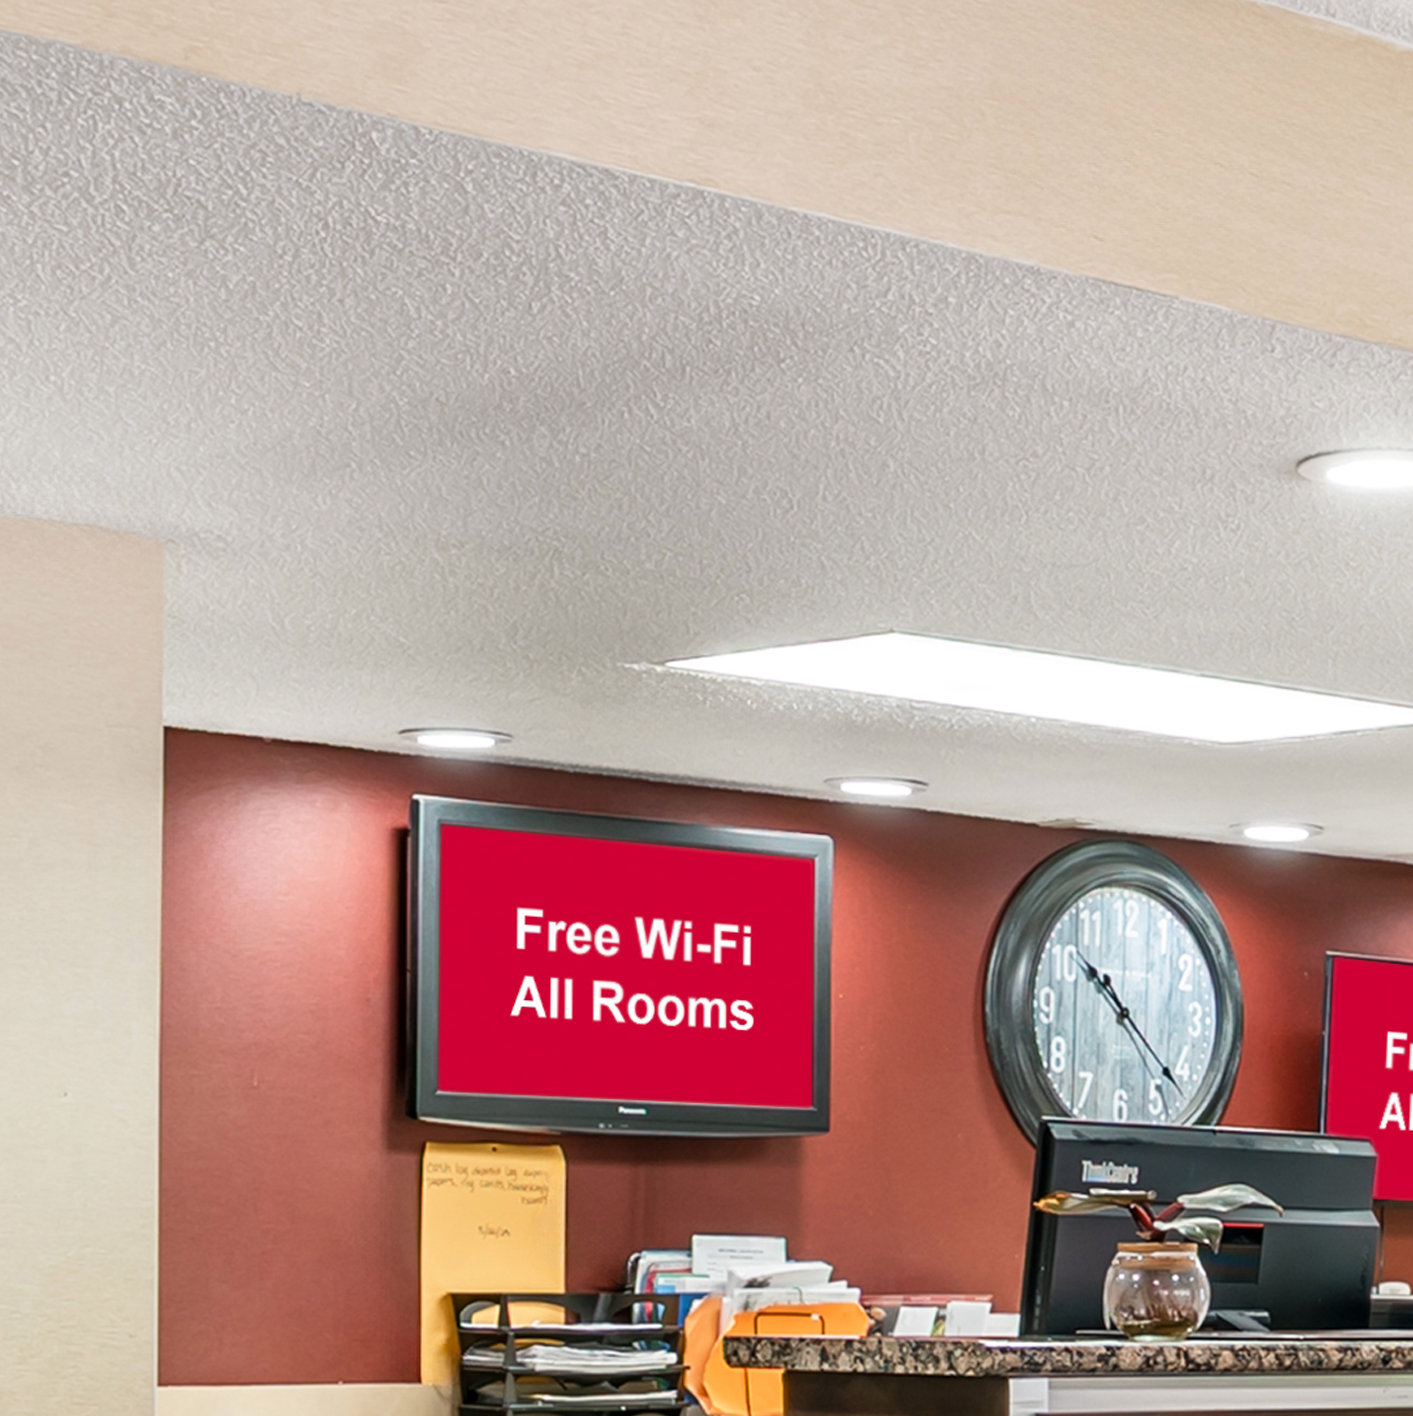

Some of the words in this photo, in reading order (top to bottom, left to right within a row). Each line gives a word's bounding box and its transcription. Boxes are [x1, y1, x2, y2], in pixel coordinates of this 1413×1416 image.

[516, 907, 621, 957] Free
[634, 916, 752, 967] Wi-Fi
[1079, 910, 1102, 947] 11
[1113, 900, 1139, 938] 12
[1158, 918, 1168, 954] 1
[1052, 945, 1077, 983] 10
[1178, 954, 1194, 992] 2
[510, 975, 573, 1020] All
[592, 980, 755, 1032] Rooms
[1039, 986, 1056, 1024] 9
[1188, 1001, 1202, 1037] 3
[1050, 1036, 1067, 1073] 8
[1174, 1046, 1191, 1081] 4
[1078, 1072, 1094, 1109] 7
[1112, 1088, 1128, 1122] 6
[1148, 1079, 1164, 1116] 5
